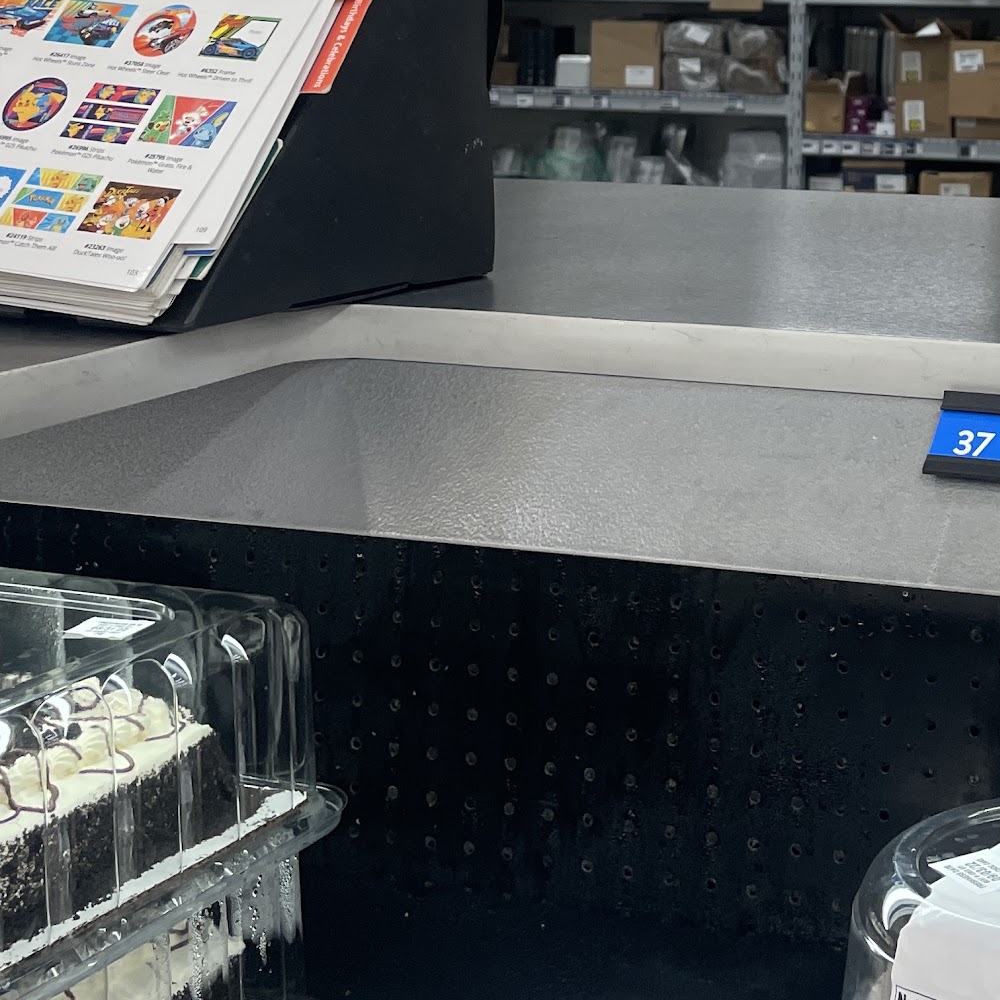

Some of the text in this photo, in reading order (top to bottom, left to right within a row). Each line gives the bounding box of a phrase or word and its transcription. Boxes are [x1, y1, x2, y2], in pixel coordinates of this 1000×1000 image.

[340, 0, 362, 34] Birthdays
[339, 34, 347, 42] &
[314, 42, 343, 89] Celebrations
[127, 268, 139, 276] 103
[953, 430, 996, 457] 37
